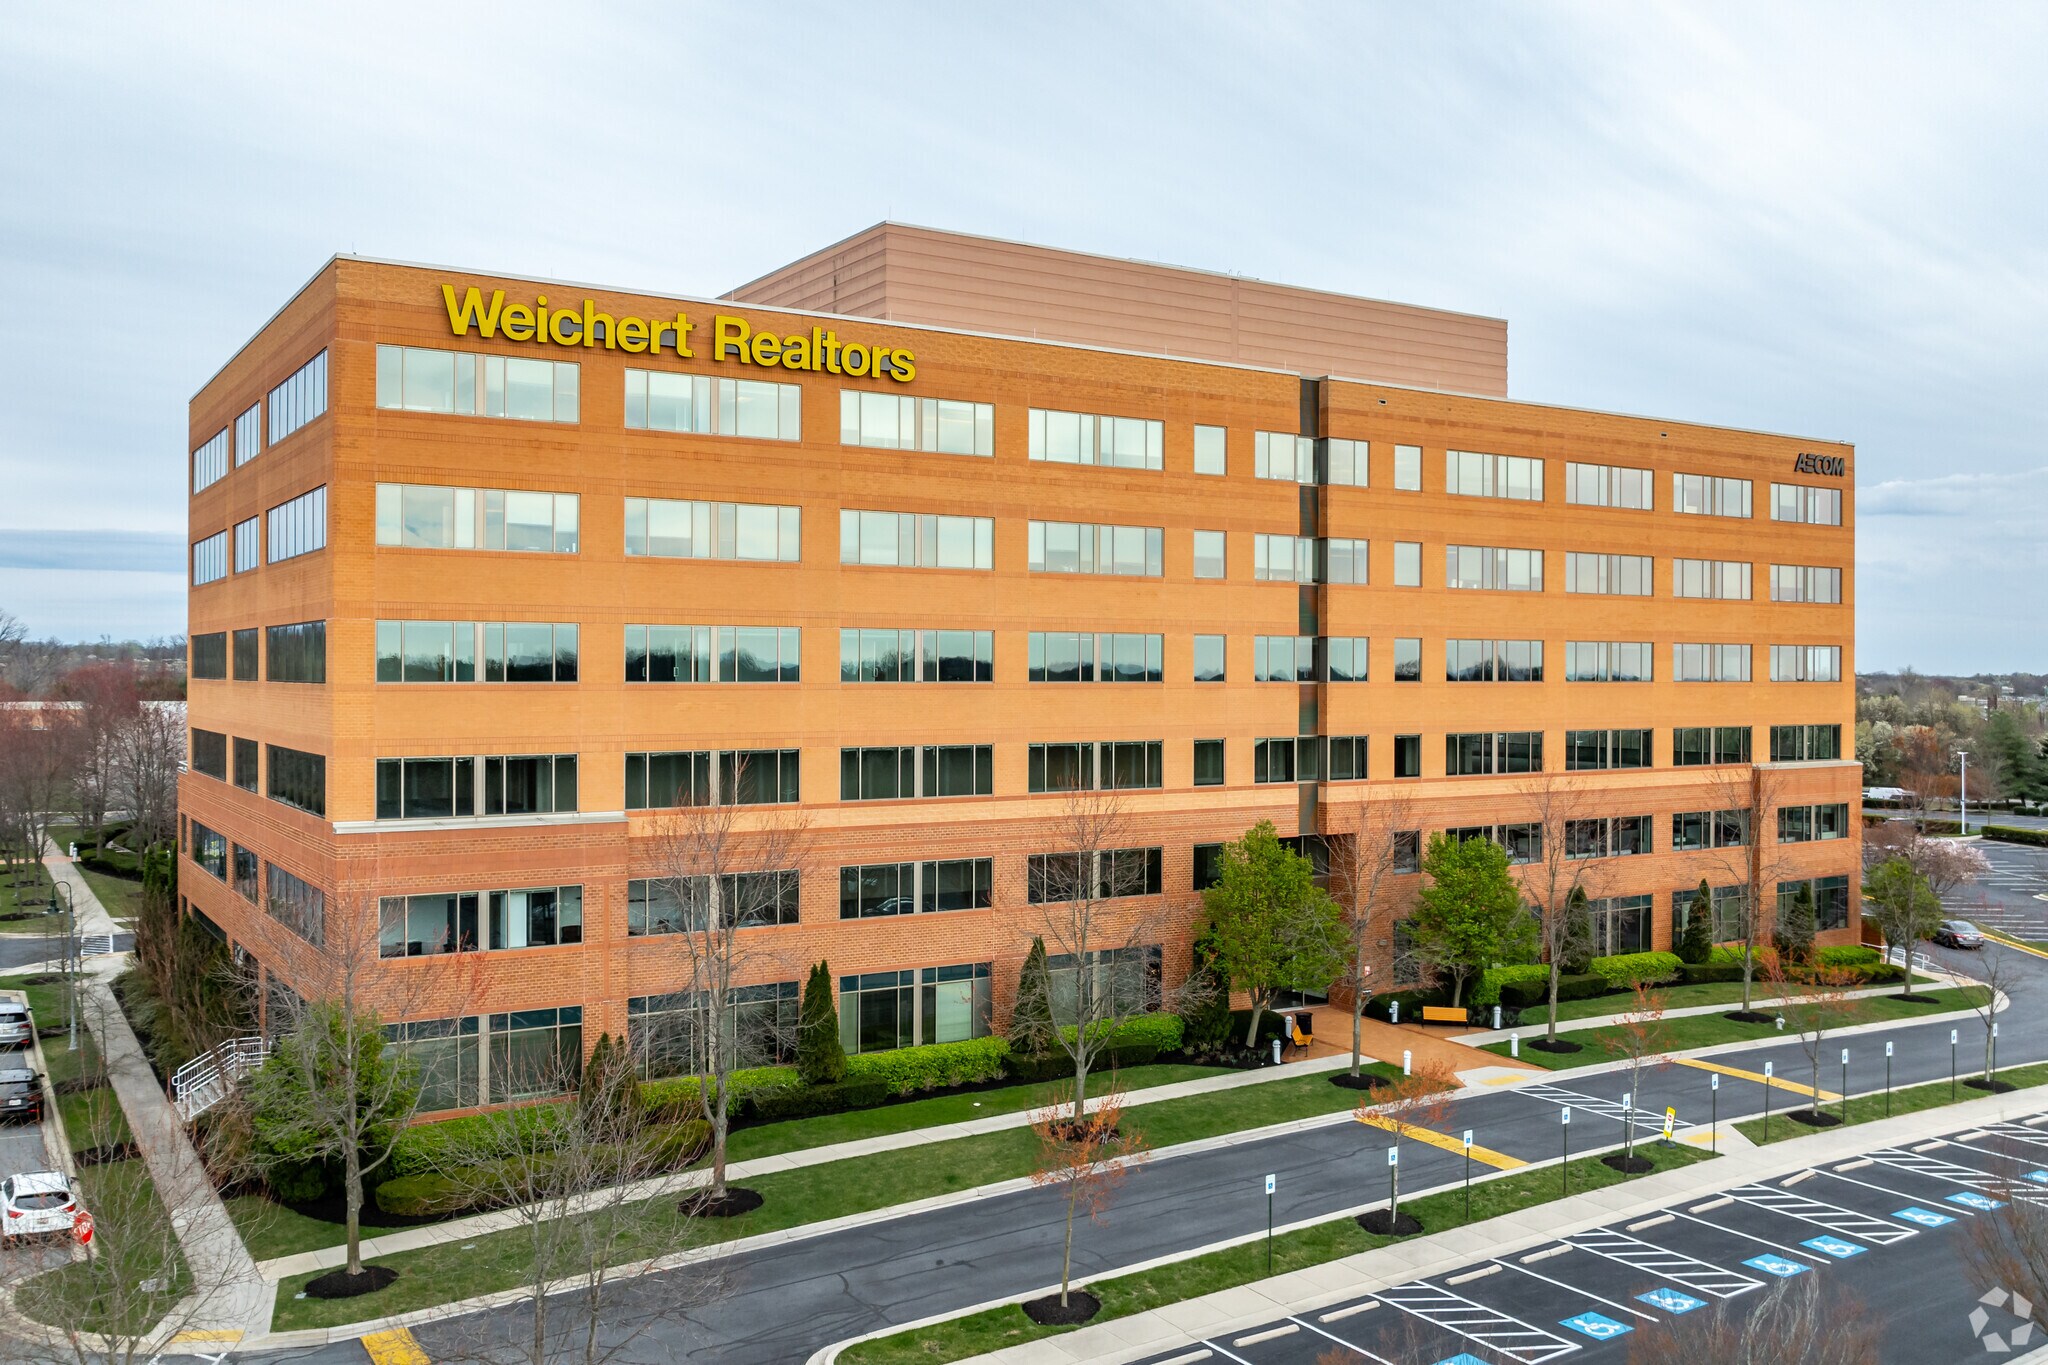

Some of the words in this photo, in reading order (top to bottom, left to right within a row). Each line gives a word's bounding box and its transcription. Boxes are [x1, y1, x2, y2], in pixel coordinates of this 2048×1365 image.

[441, 284, 694, 358] Weichert
[714, 314, 916, 382] Realtors
[1794, 453, 1844, 476] AECOM
